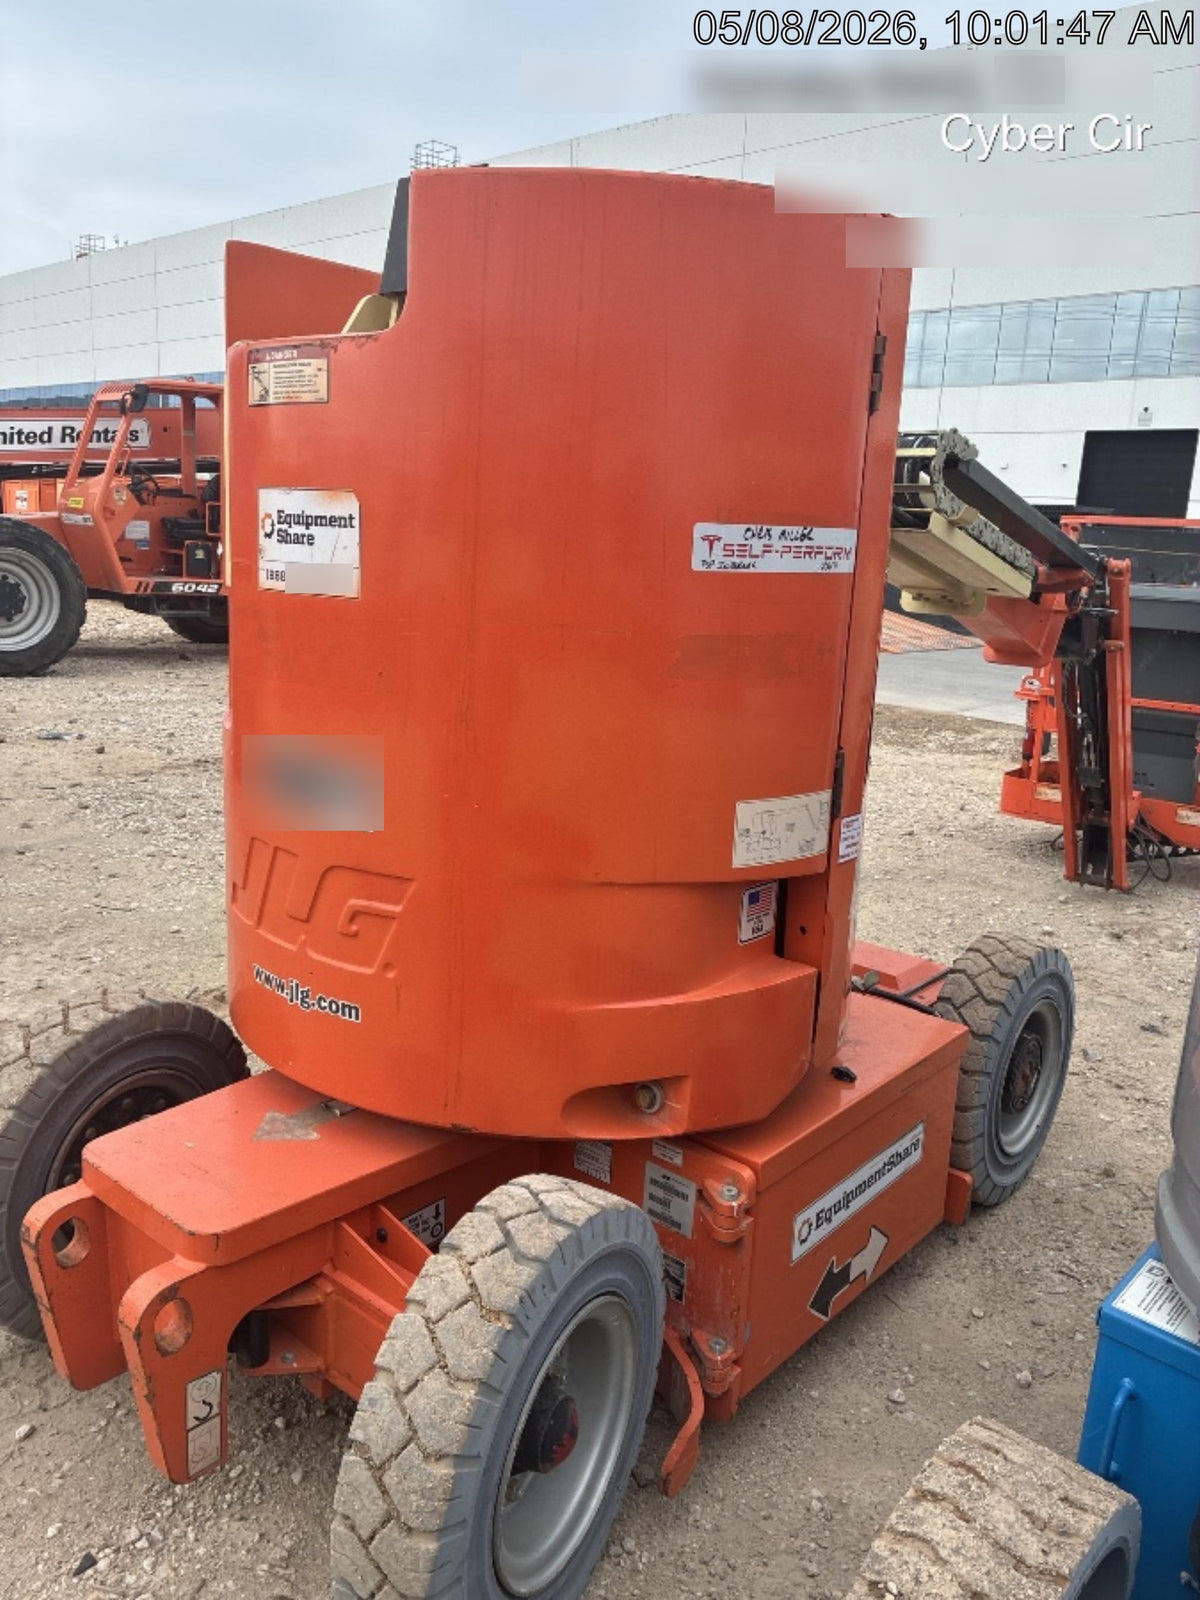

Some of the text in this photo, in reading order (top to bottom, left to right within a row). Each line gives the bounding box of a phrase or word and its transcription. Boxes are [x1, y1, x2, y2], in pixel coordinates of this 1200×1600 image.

[60, 426, 139, 444] Rntas
[276, 509, 356, 532] Equipment
[276, 529, 315, 546] Share
[171, 582, 219, 594] 6042
[253, 964, 361, 1022] www.jlg.com
[815, 1136, 921, 1230] EquipmentShare
